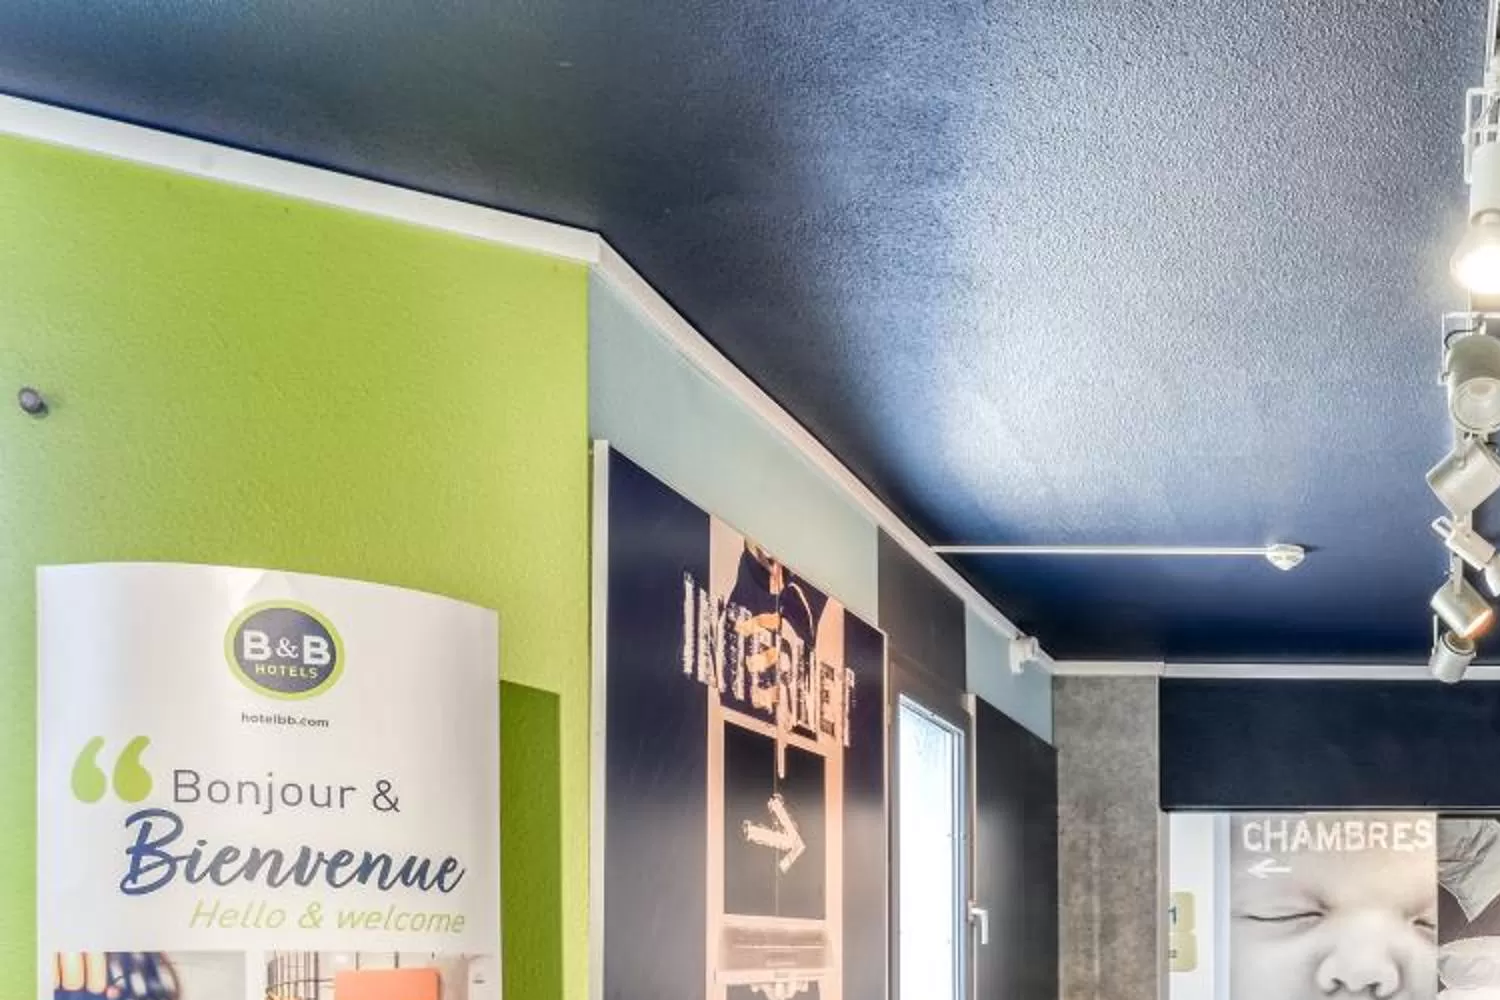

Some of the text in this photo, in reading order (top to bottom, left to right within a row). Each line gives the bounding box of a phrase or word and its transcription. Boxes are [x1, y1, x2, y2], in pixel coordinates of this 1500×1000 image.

[255, 663, 318, 679] HOTELS
[683, 571, 855, 748] INTERNET
[241, 711, 329, 728] hotelbb.com
[174, 769, 401, 814] Bonjour &
[119, 807, 465, 896] Bienvenue
[1242, 818, 1435, 852] CHAMBRES
[189, 899, 465, 935] Hello & welcome
